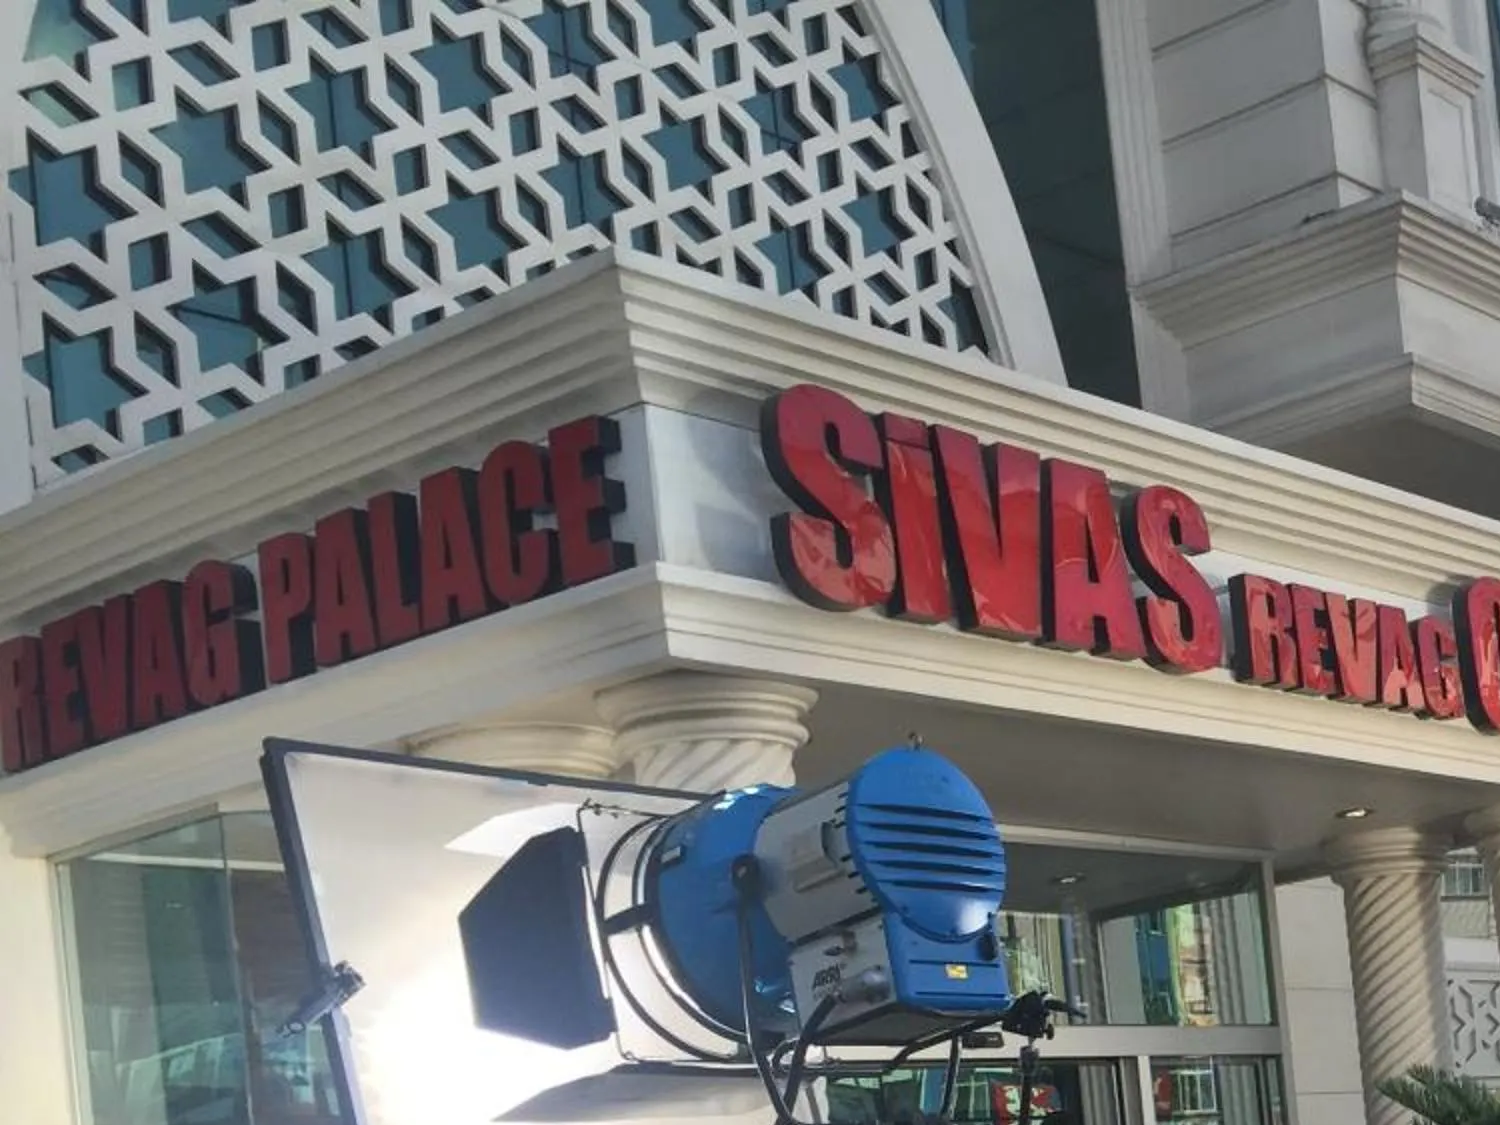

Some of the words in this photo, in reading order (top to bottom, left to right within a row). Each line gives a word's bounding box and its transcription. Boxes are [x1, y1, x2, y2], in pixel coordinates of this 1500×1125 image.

[0, 560, 264, 776] REVAG
[258, 413, 637, 686] PALACE
[1228, 572, 1463, 721] REVAG
